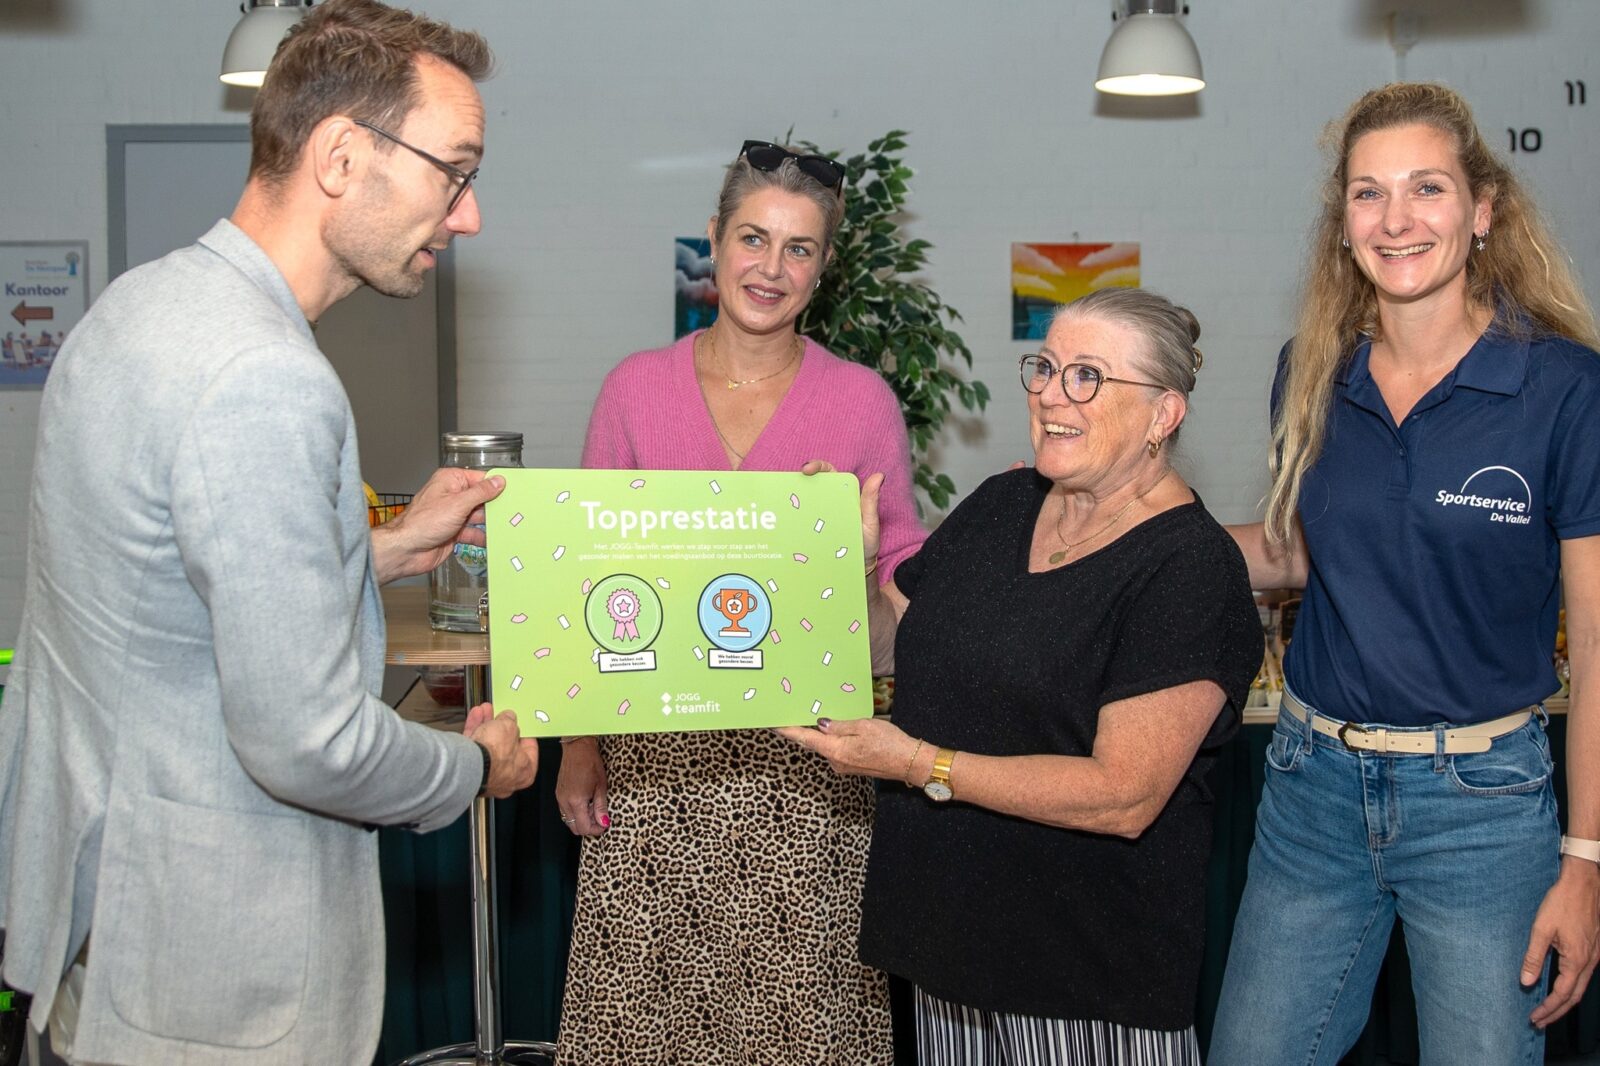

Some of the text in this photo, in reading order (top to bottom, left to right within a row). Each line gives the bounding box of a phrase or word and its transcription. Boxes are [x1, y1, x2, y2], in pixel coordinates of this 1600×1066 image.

[1564, 80, 1586, 106] 11
[1507, 127, 1542, 153] 10
[5, 282, 69, 296] Kantoor
[1435, 489, 1526, 513] Sportservice
[579, 500, 777, 539] Topprestatie
[1490, 512, 1531, 525] De Vallei
[593, 543, 608, 551] Met
[609, 542, 660, 551] JOGG-Teamfit
[661, 543, 685, 551] werken
[698, 544, 712, 552] stap
[729, 544, 744, 552] stap
[757, 543, 769, 551] het
[716, 553, 726, 561] op
[675, 692, 701, 702] JOGG
[675, 700, 721, 714] teamfit
